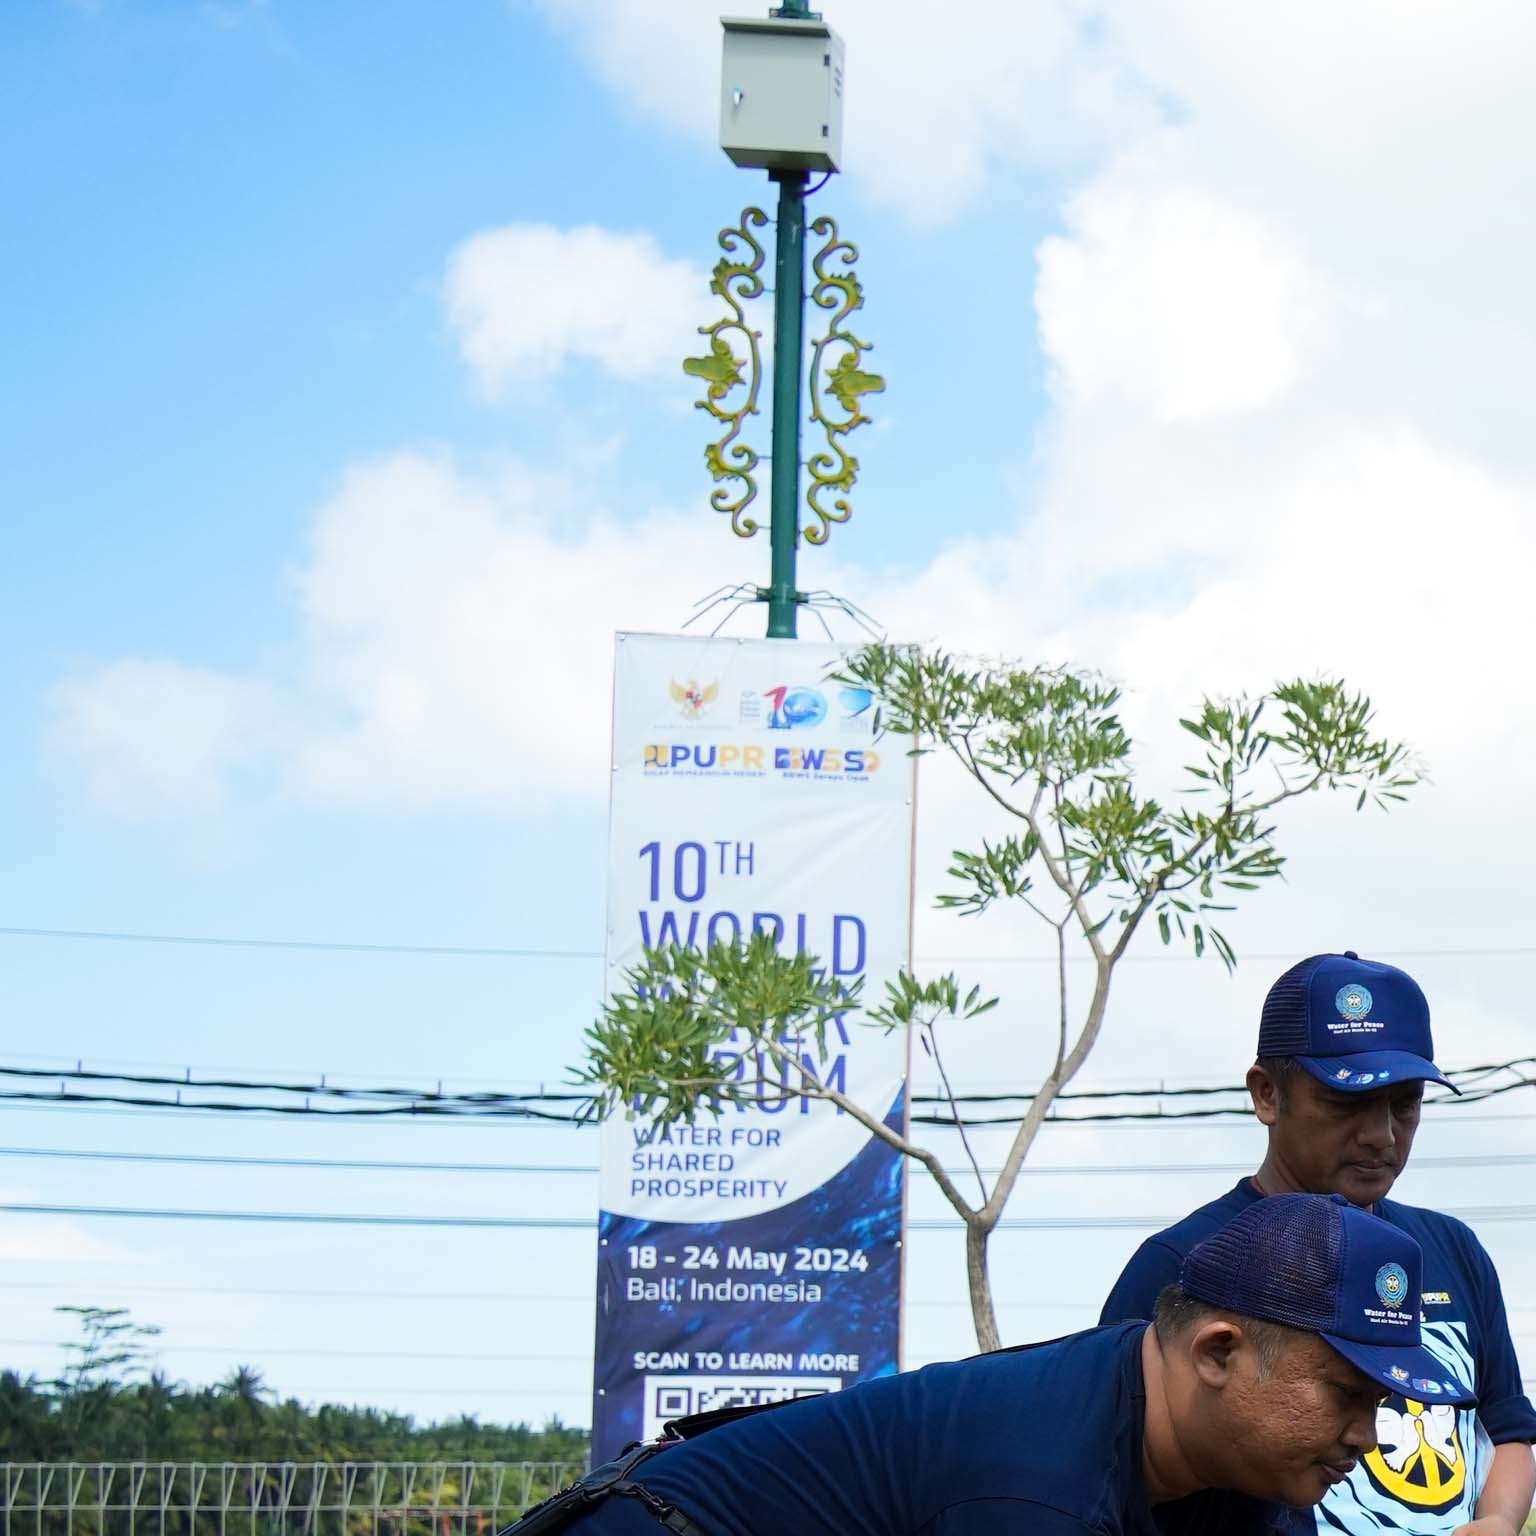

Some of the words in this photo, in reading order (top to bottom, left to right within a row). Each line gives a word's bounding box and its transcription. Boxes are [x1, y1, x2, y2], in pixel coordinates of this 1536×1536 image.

[731, 1128, 781, 1147] FOR
[632, 1153, 734, 1172] SHARED
[631, 1178, 788, 1198] PROSPERITY
[627, 1246, 657, 1270] 18
[682, 1246, 719, 1270] 24
[726, 1247, 788, 1276] May
[794, 1248, 869, 1273] 2024
[627, 1277, 681, 1302] Bali,
[690, 1277, 822, 1303] Indonesia
[633, 1351, 690, 1370] SCAN
[695, 1351, 723, 1370] TO
[729, 1352, 793, 1371] LEARN
[798, 1353, 859, 1372] MORE
